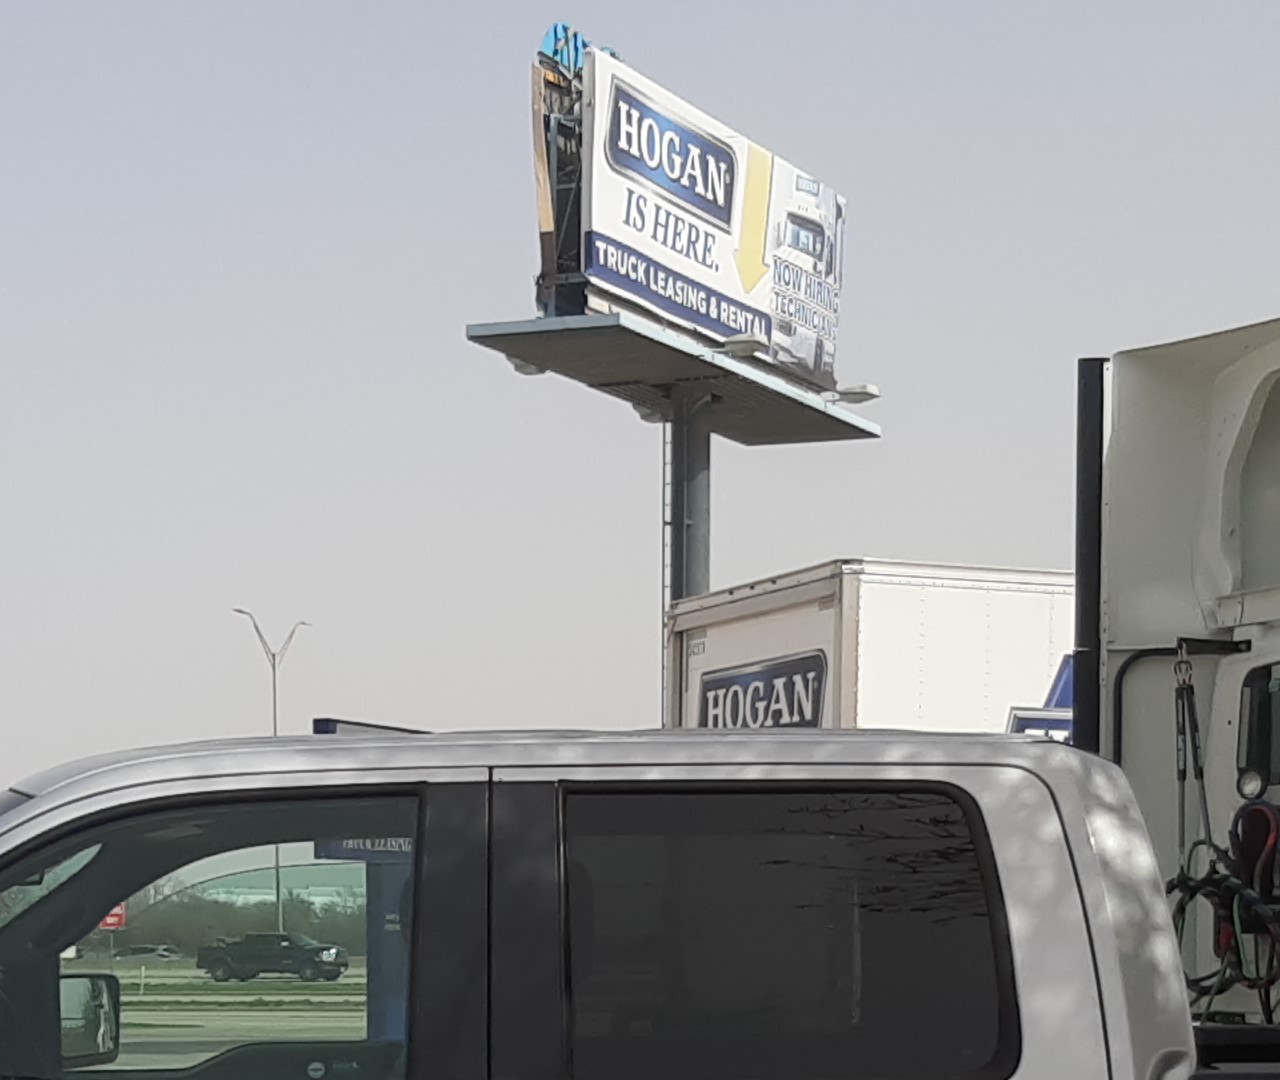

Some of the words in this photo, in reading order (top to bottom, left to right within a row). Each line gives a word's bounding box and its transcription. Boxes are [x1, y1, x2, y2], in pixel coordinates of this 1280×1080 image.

[618, 100, 727, 207] HOGAN
[622, 187, 647, 233] IS
[651, 203, 719, 273] HERE.
[595, 241, 646, 286] TRUCK
[649, 265, 707, 314] LEASING
[709, 296, 718, 320] &
[720, 300, 768, 338] RENTAL
[773, 258, 803, 292] NOW
[804, 270, 839, 314] HIRING
[706, 671, 816, 729] HOGAN
